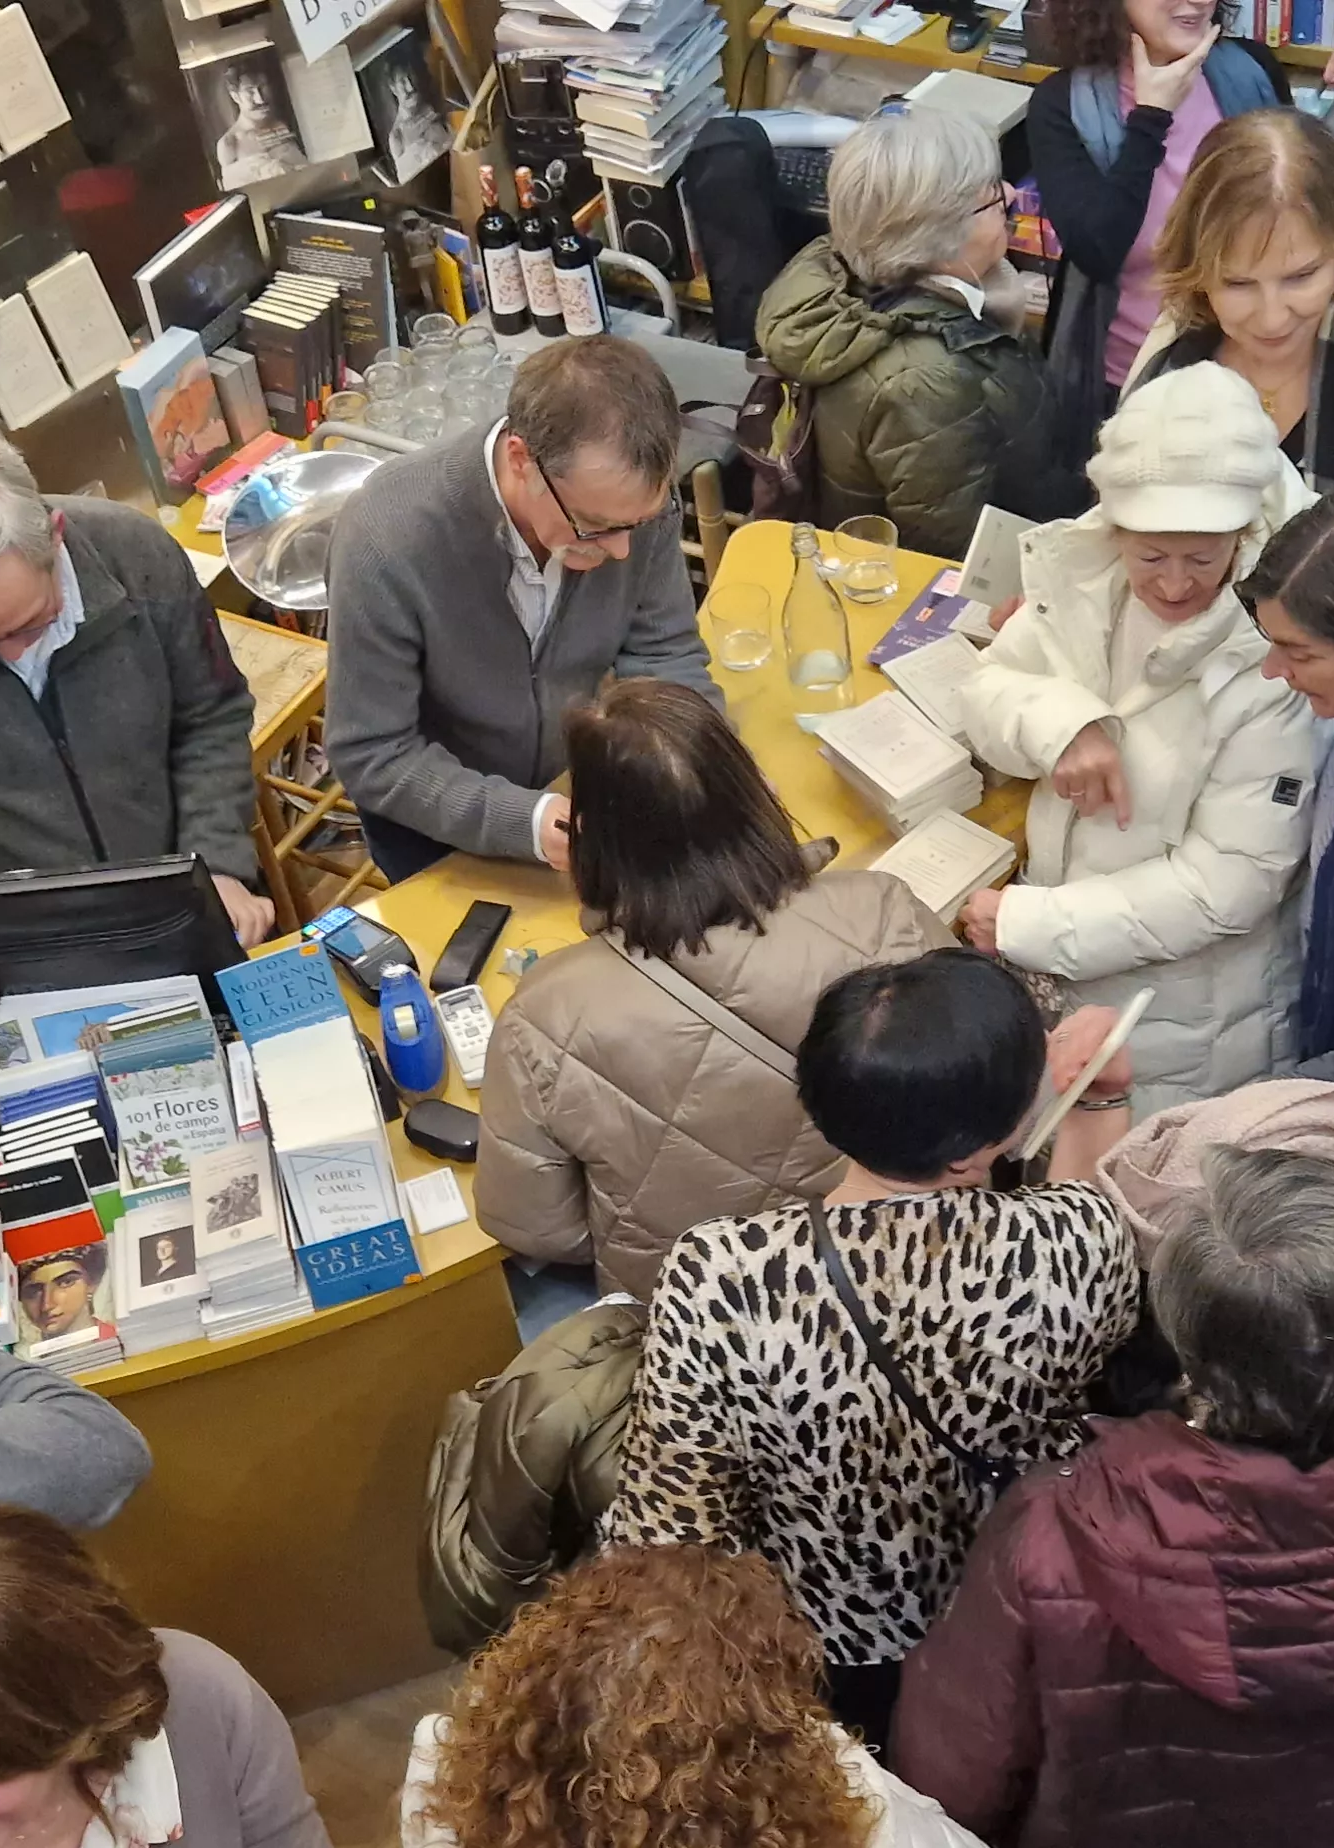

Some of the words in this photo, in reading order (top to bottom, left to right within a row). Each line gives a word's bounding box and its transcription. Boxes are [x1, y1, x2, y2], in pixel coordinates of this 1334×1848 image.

[230, 961, 324, 996] MODERNOS
[255, 958, 288, 973] LOS
[237, 971, 328, 1014] LEEN
[125, 1111, 152, 1125] 101
[153, 1097, 219, 1119] Flores
[155, 1122, 172, 1133] de
[175, 1115, 220, 1130] campo
[314, 1168, 363, 1183] ALBERT
[317, 1183, 366, 1197] CAMUS
[307, 1229, 401, 1265] GREAT
[311, 1242, 406, 1280] IDEAS
